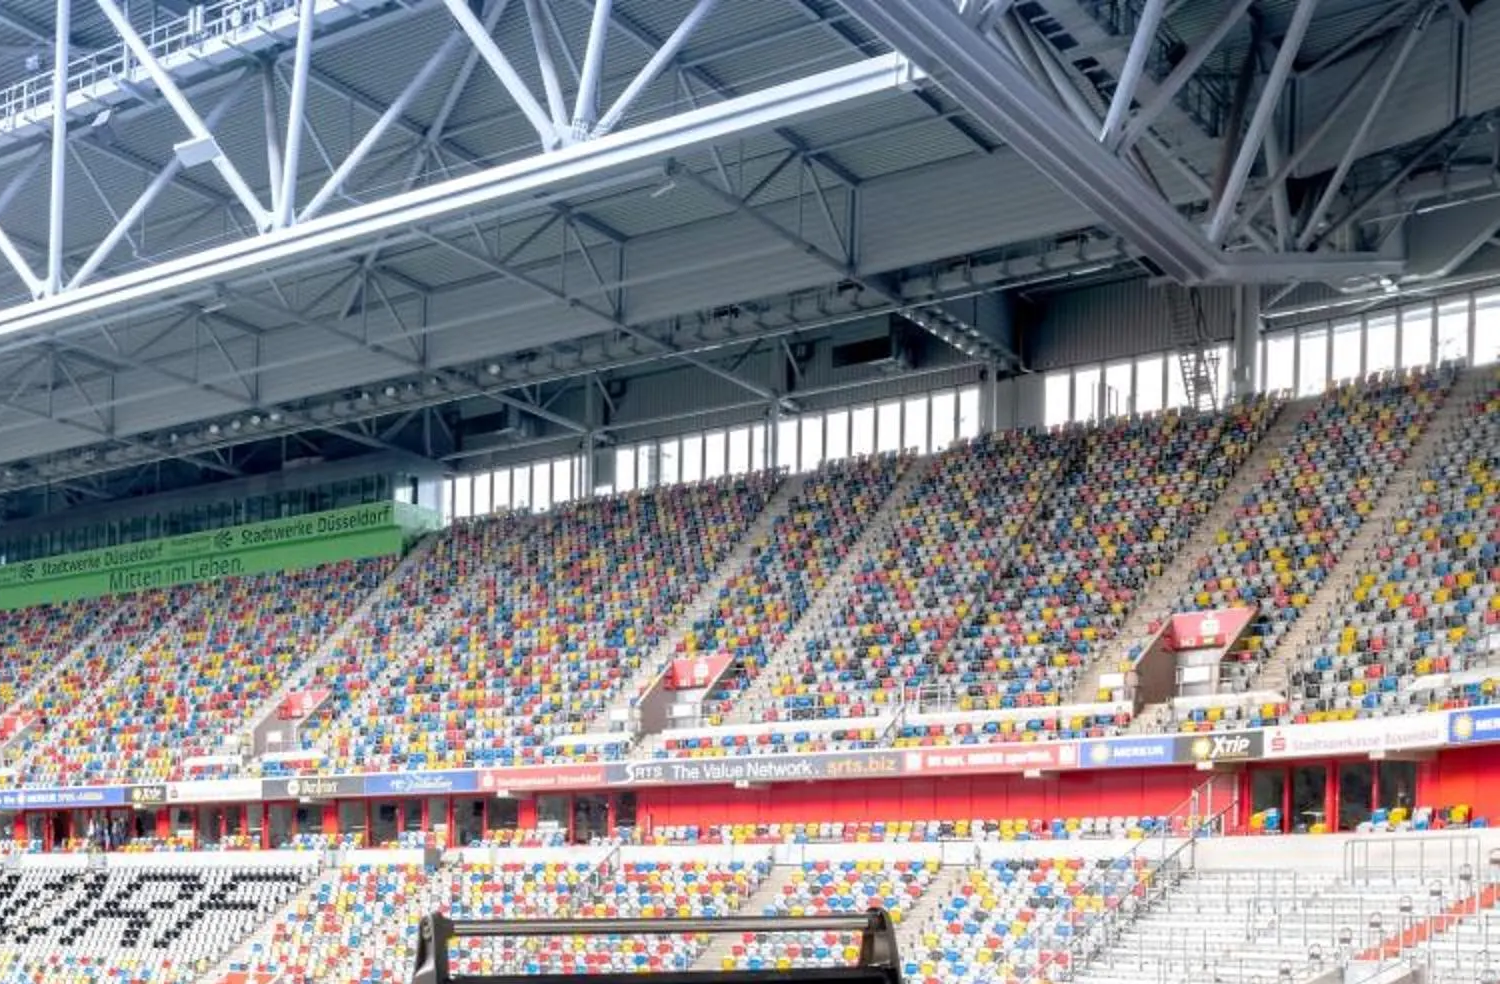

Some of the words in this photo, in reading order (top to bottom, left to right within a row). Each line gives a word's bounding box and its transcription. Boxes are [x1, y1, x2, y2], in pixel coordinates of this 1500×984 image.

[241, 519, 313, 546] Stadtwerke
[317, 505, 393, 533] Düsseldorf
[40, 555, 100, 577] Stadtwerke
[104, 544, 164, 567] Düsseldorf
[109, 567, 161, 592] Mitten
[191, 555, 245, 580] Leben.
[672, 764, 700, 780] The
[704, 761, 743, 779] Value
